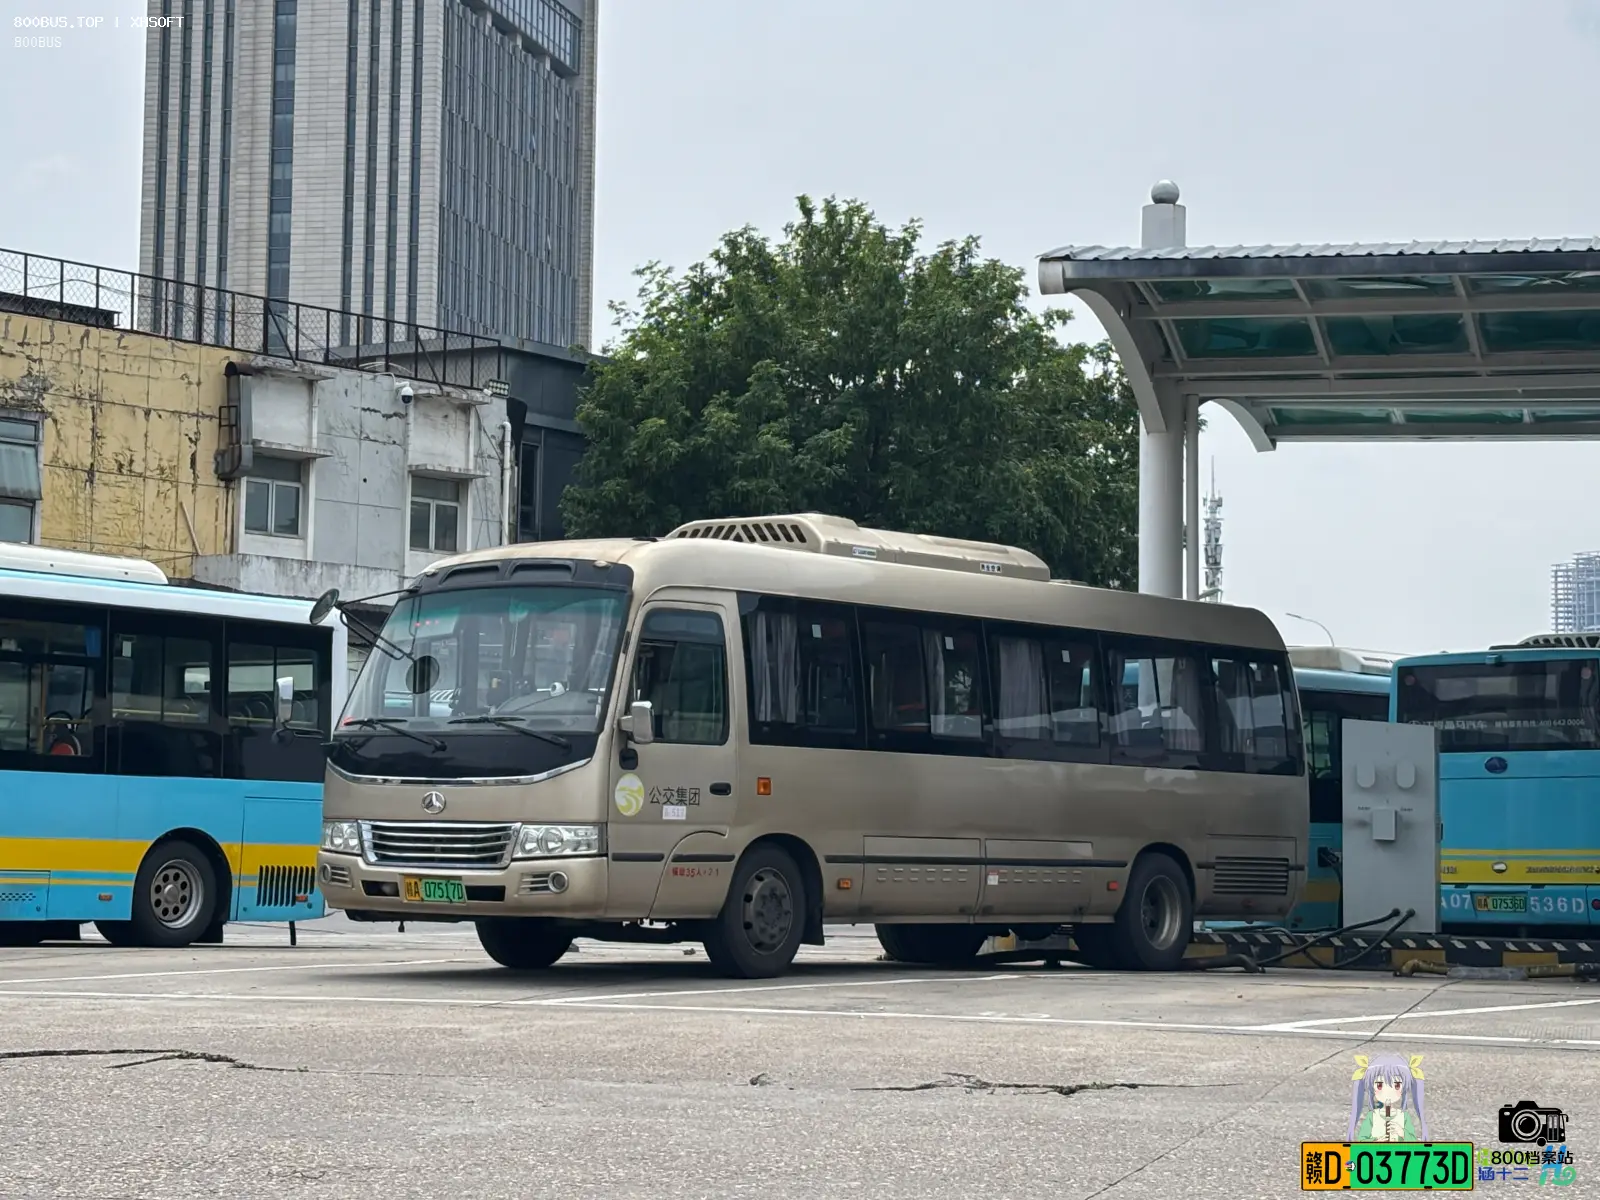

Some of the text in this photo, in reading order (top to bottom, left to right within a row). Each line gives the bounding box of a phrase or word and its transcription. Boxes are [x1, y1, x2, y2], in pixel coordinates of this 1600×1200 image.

[648, 785, 701, 806] 公交集团
[424, 881, 464, 900] 07517D
[1492, 898, 1525, 910] 07536D
[1529, 896, 1585, 914] 536D
